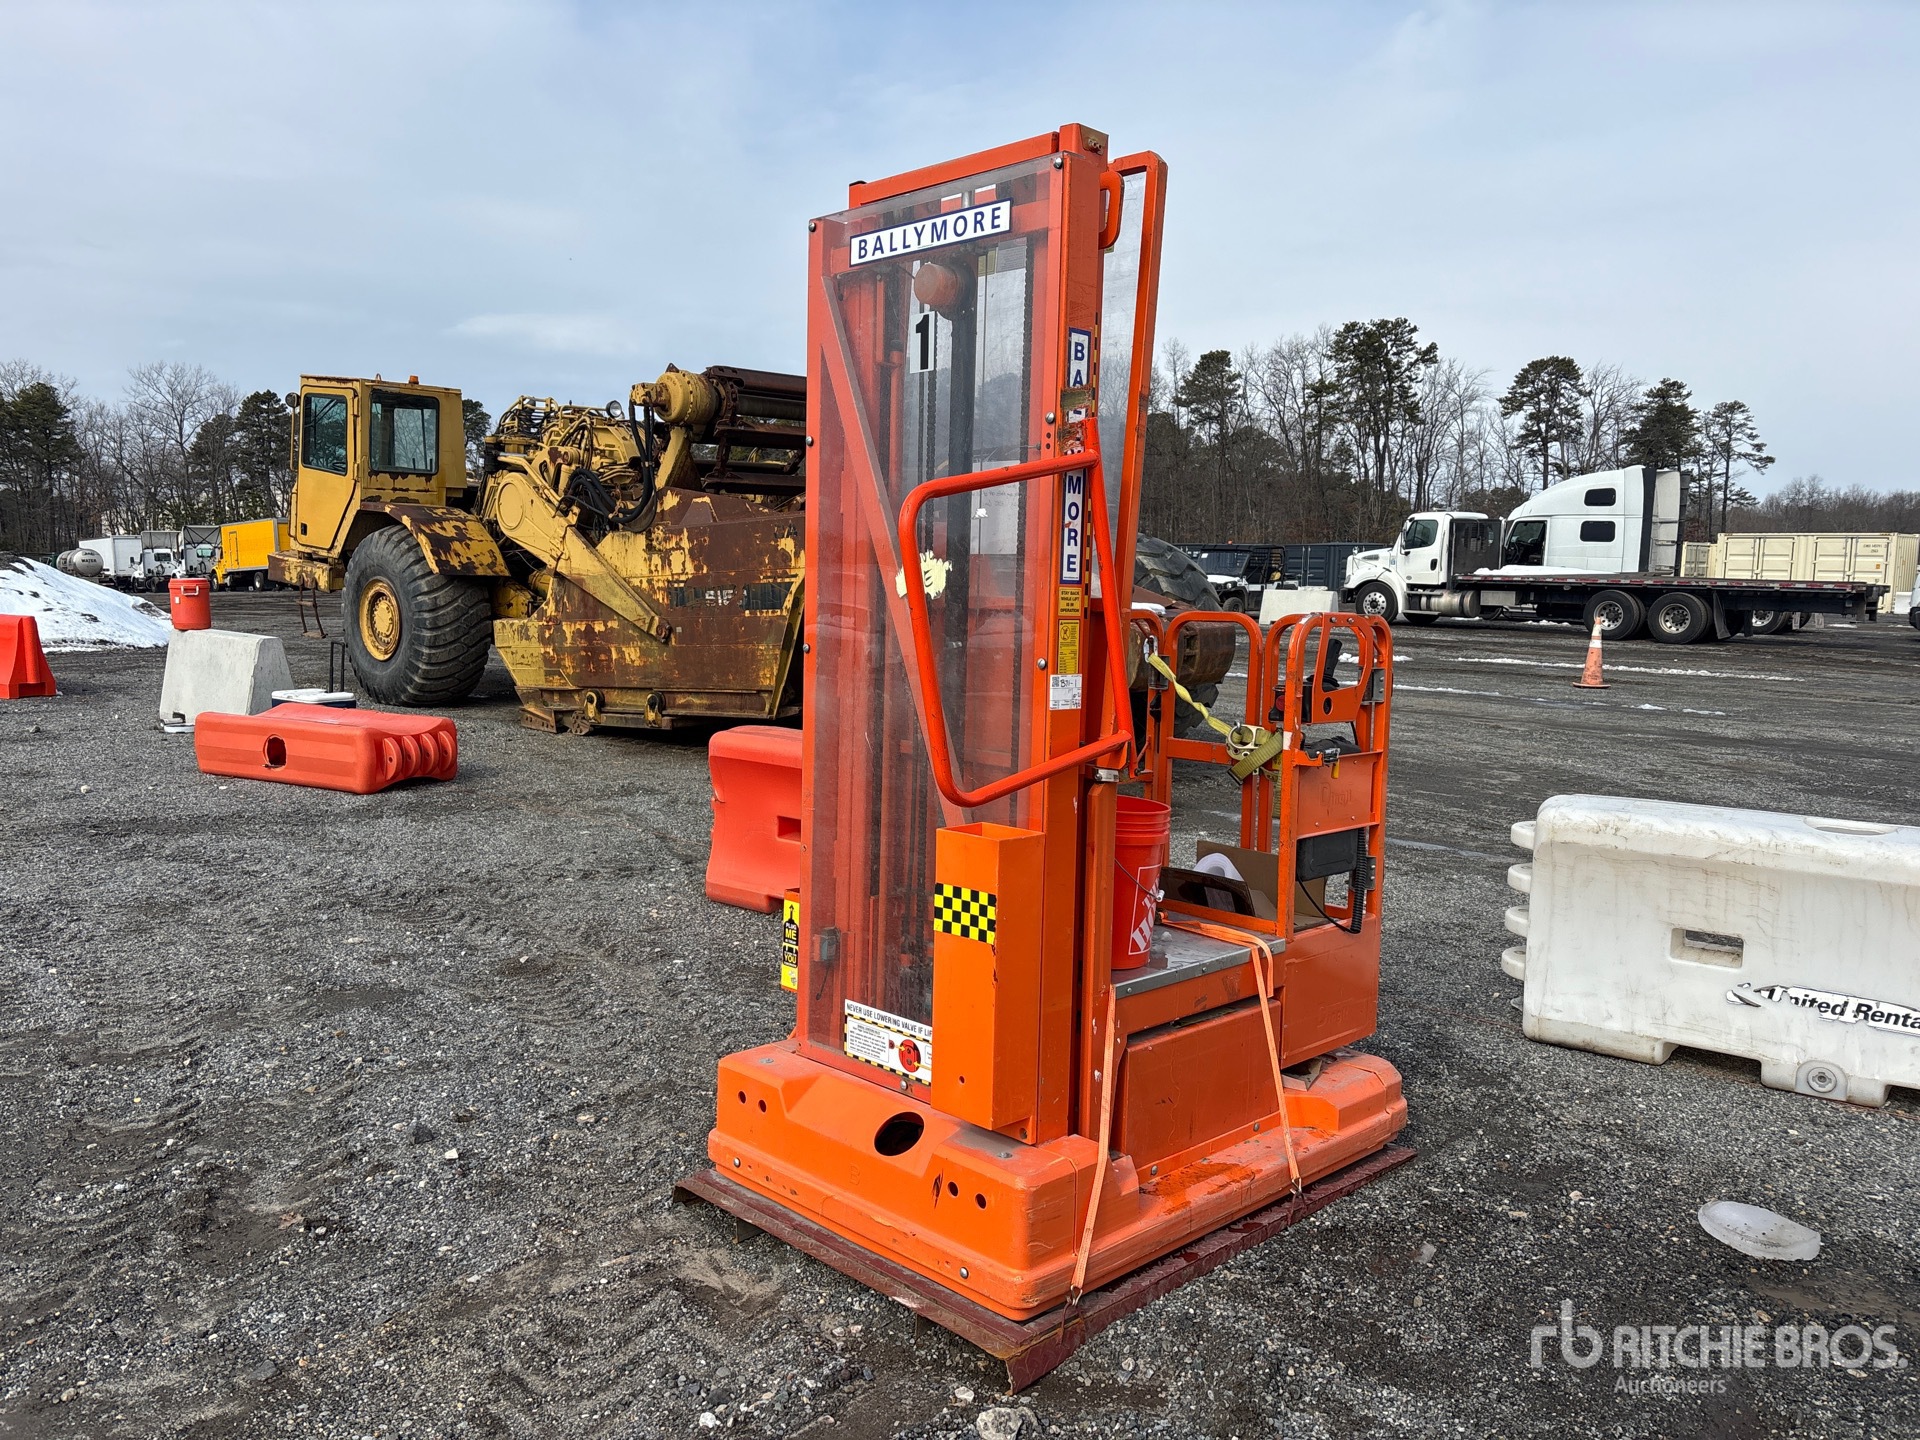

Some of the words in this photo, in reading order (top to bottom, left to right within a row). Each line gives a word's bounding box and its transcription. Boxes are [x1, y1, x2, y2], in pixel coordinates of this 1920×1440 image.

[857, 206, 1003, 260] BALLYMORE
[915, 313, 931, 371] 1
[1067, 341, 1086, 573] BAMORE
[785, 928, 797, 941] ME
[784, 953, 797, 965] YOU
[846, 1002, 863, 1015] NEVER
[863, 1008, 873, 1018] USE
[874, 1012, 901, 1027] LOWERING
[901, 1019, 918, 1032] VALVE
[918, 1024, 924, 1034] IF
